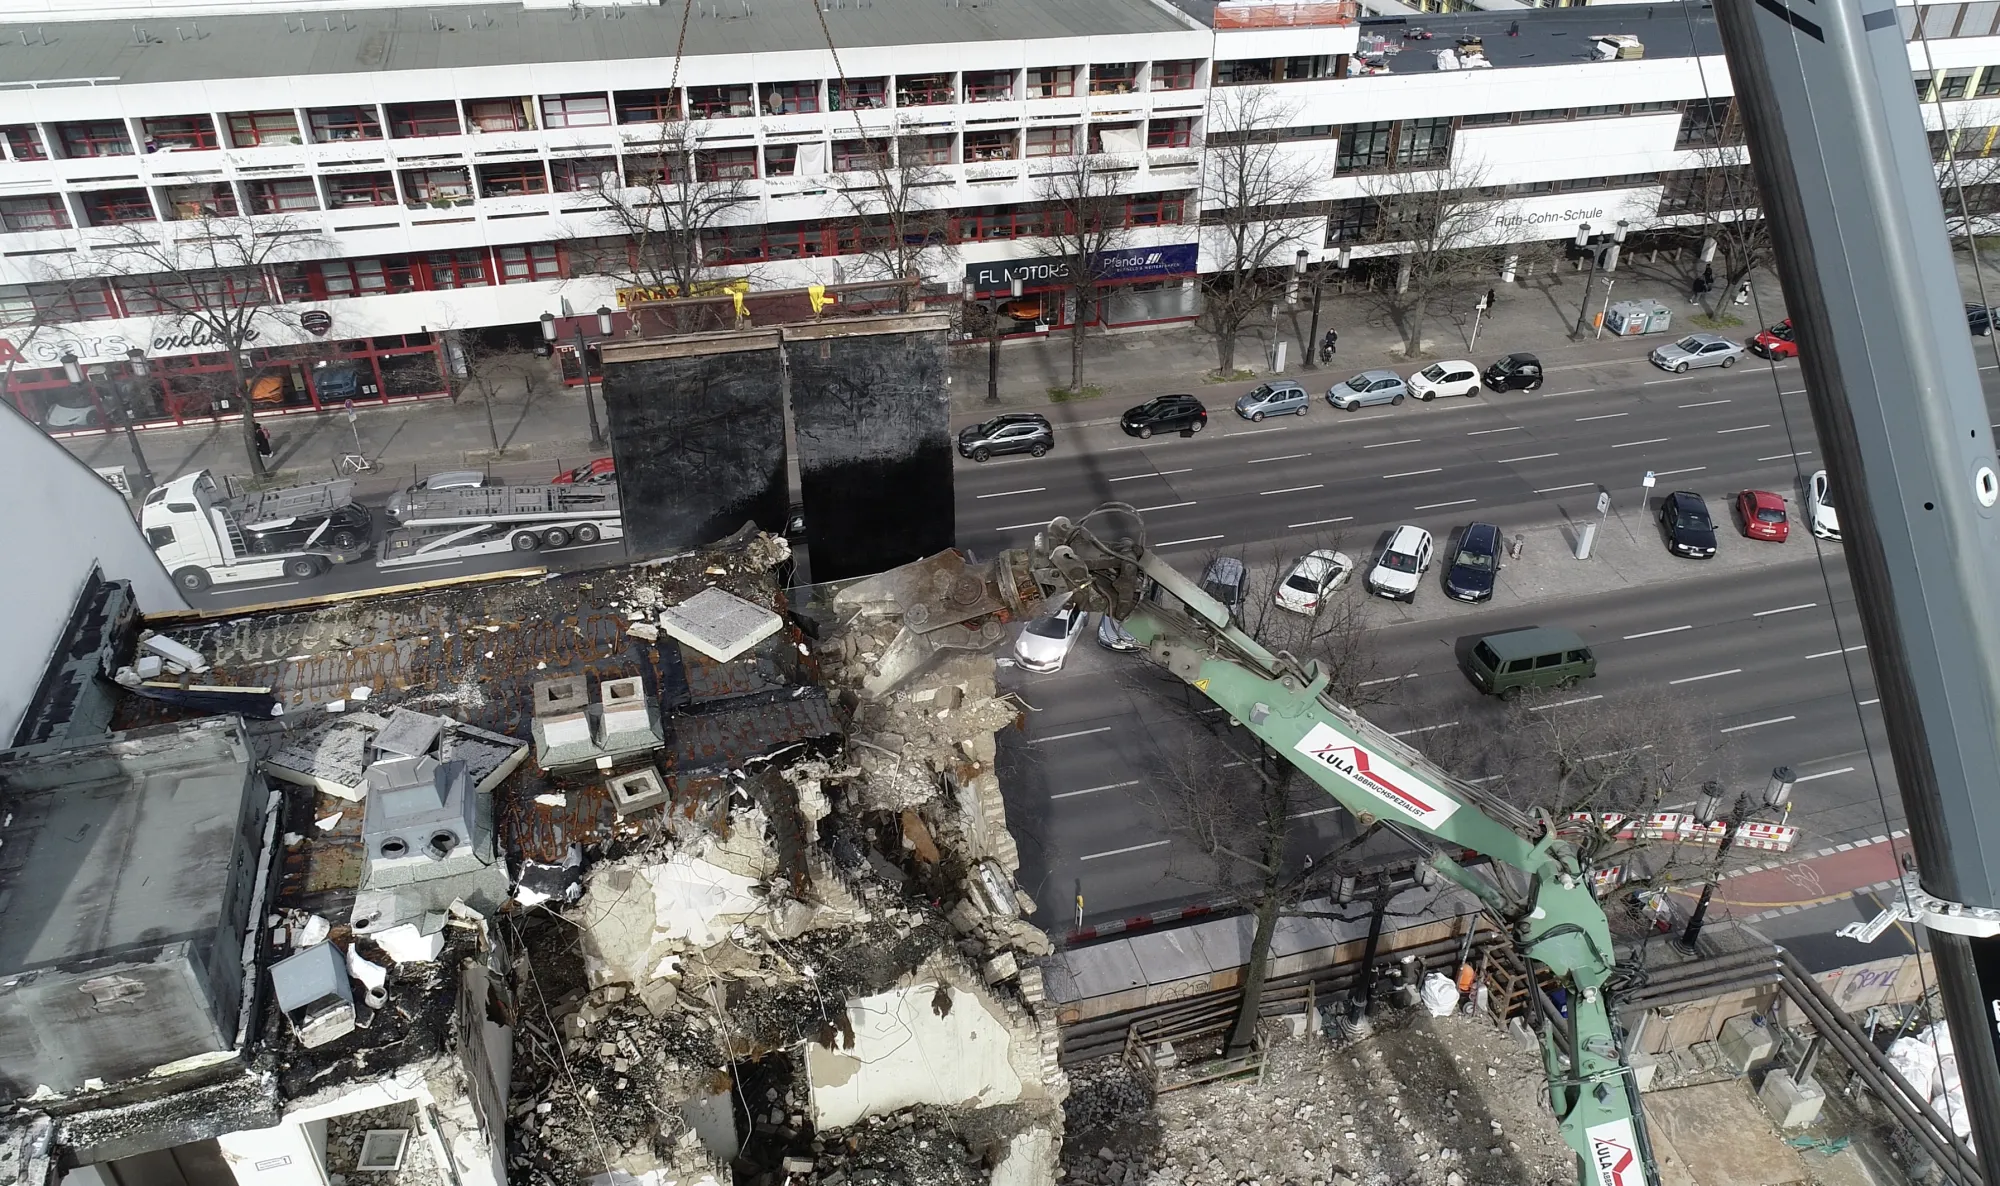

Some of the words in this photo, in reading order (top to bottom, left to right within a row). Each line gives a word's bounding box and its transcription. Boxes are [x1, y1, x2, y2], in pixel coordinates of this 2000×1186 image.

[1495, 207, 1603, 227] Ruth-Cohn-Schule
[1104, 255, 1144, 268] Pfando
[980, 270, 999, 285] FL
[154, 321, 260, 350] excluse
[32, 336, 128, 361] cars
[1317, 751, 1354, 775] LULA
[1353, 774, 1425, 817] ABBRUCHSPEZIALIST
[1595, 1142, 1613, 1170] LULA
